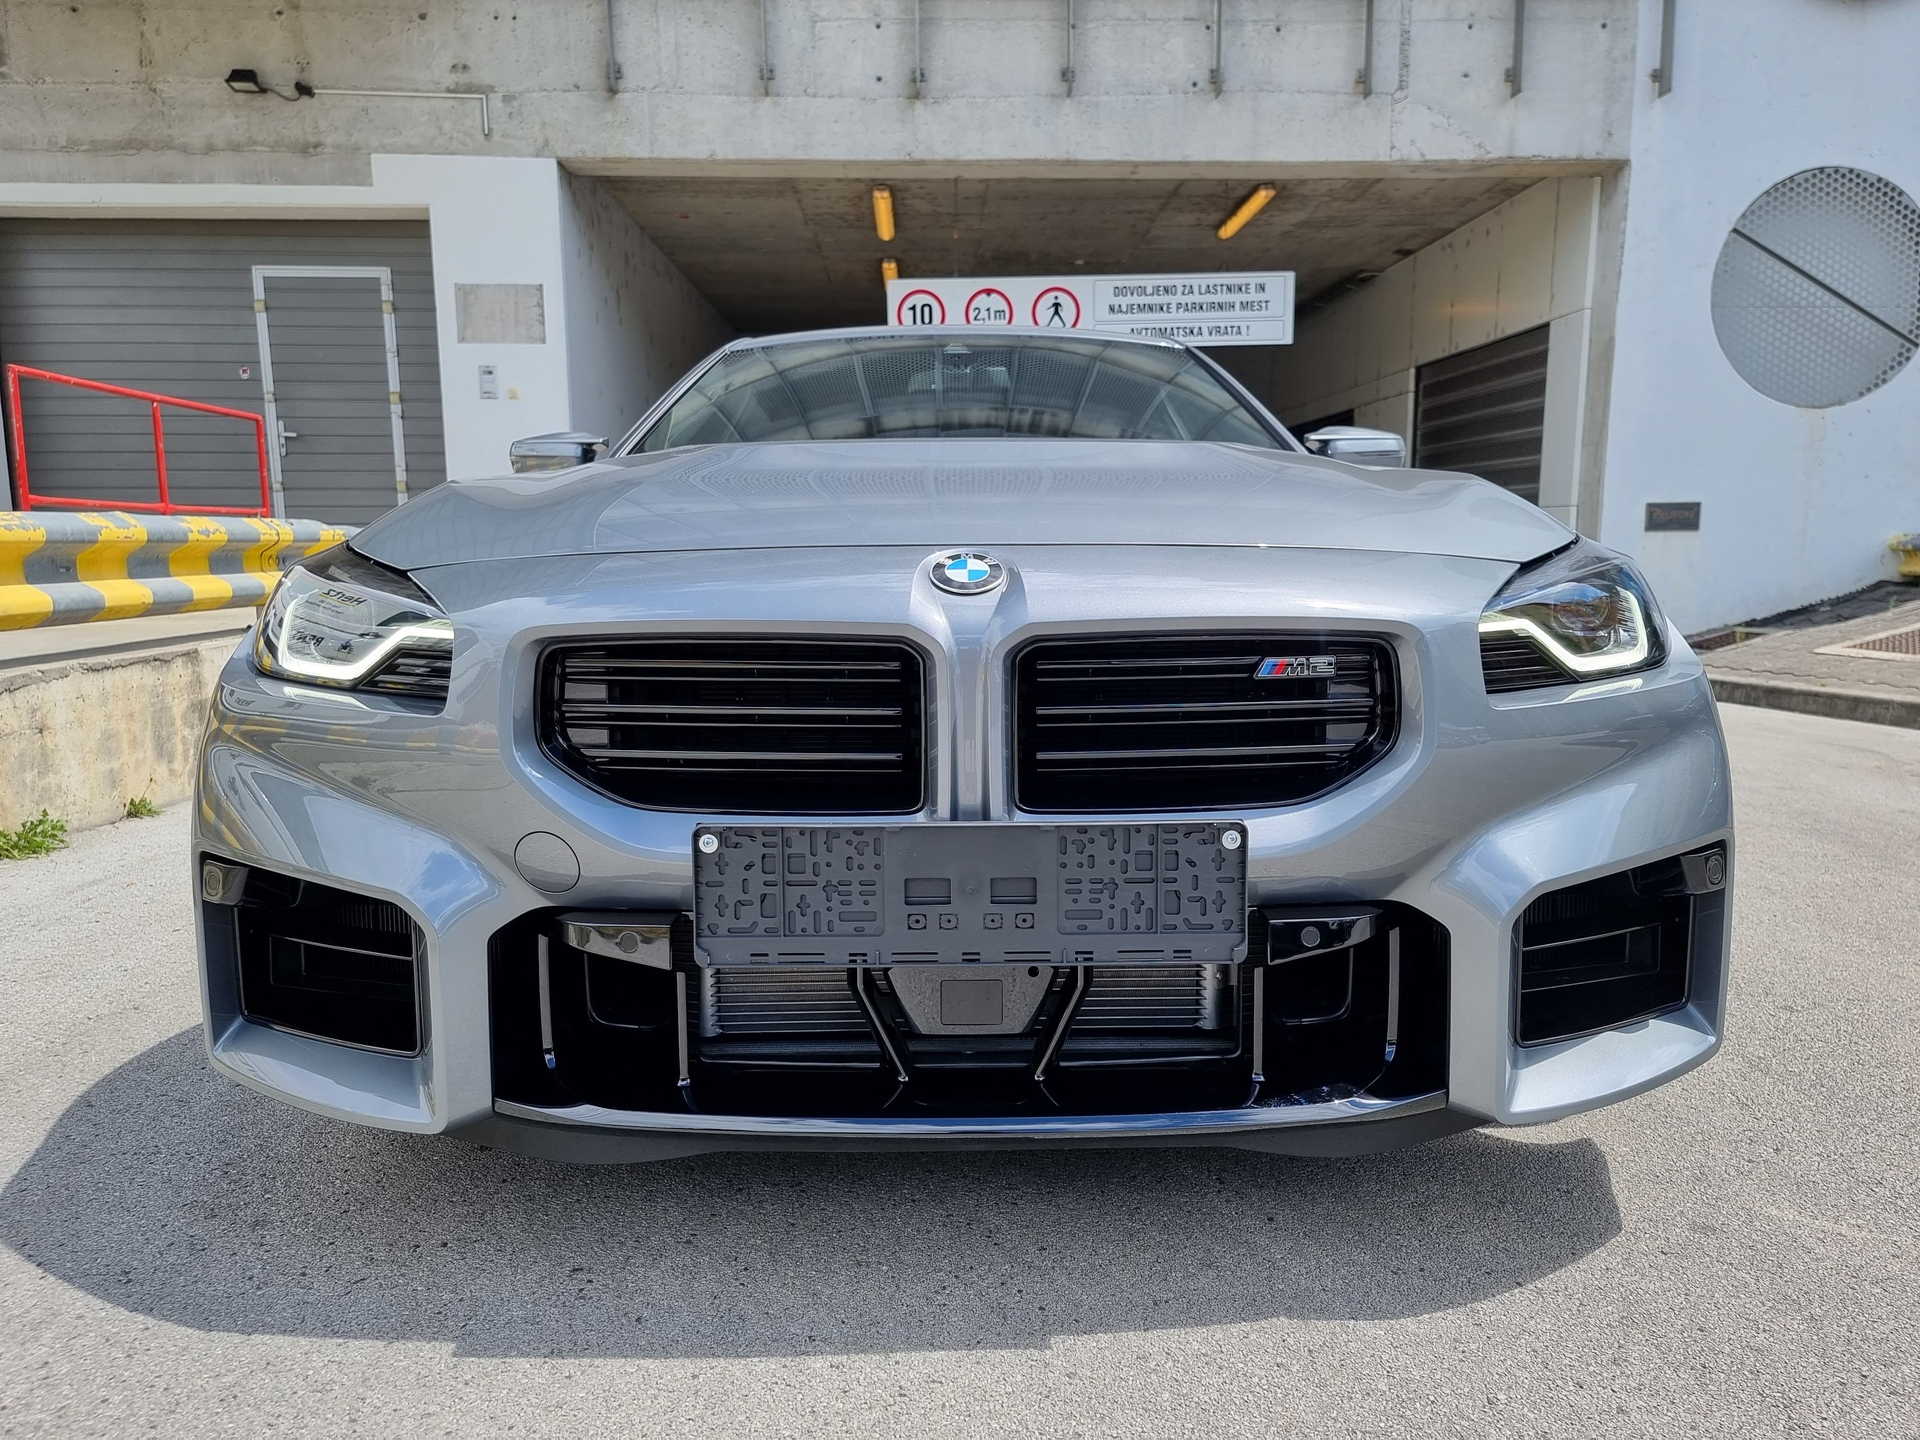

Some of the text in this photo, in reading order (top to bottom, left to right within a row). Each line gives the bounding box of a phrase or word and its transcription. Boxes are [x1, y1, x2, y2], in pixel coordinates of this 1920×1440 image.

[1113, 283, 1266, 298] DOVOLJENO ZA LASTNIKE IN
[908, 303, 933, 325] 10
[1108, 300, 1271, 315] NAJEMNIKE PARKIRNIH MEST
[1206, 325, 1242, 338] VRATA
[1276, 656, 1336, 677] M2
